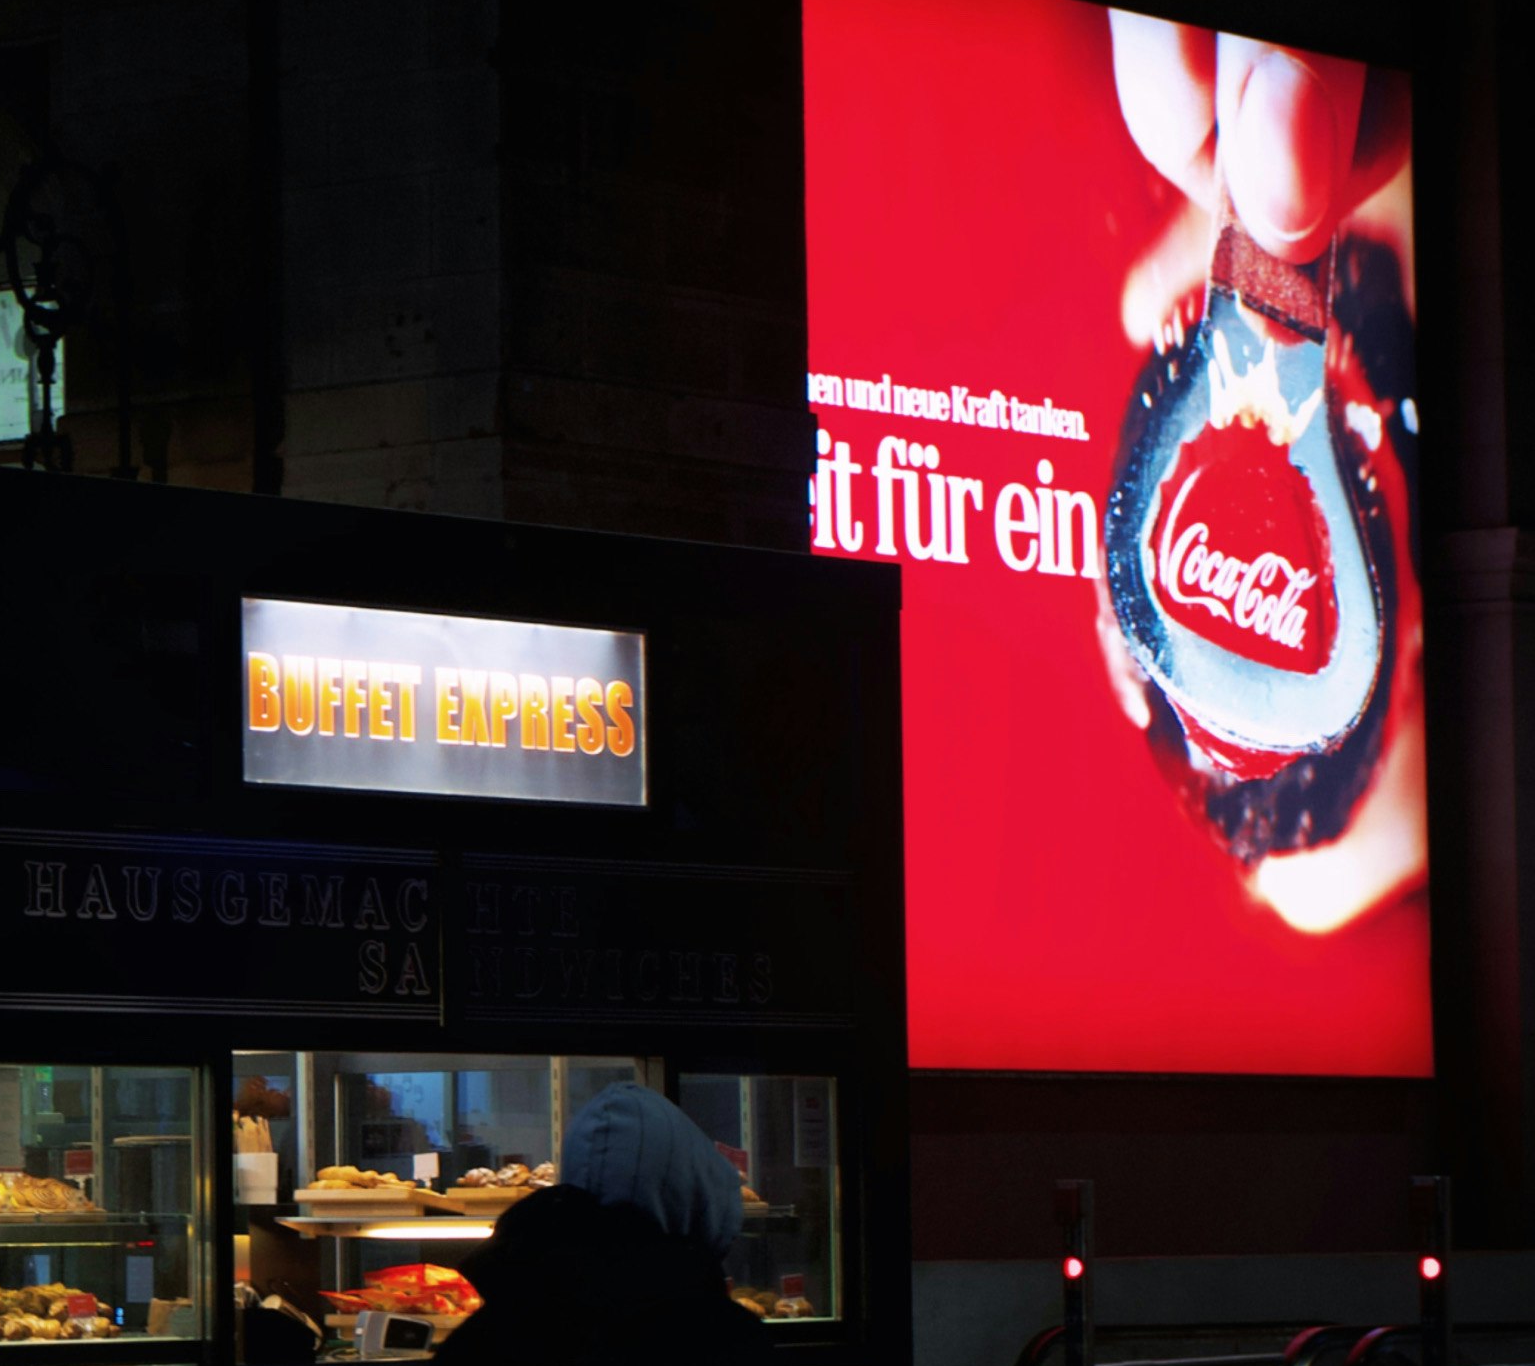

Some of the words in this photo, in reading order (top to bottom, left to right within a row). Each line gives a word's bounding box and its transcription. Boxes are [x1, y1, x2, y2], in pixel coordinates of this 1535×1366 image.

[845, 374, 892, 414] und
[892, 385, 950, 422] neue
[951, 385, 1010, 430] Kraft
[1010, 396, 1091, 441] tanken.
[809, 428, 863, 553] it
[871, 435, 983, 565] für
[994, 458, 1102, 579] ein
[248, 651, 422, 743] BUFFET
[434, 667, 635, 757] EXPRESS
